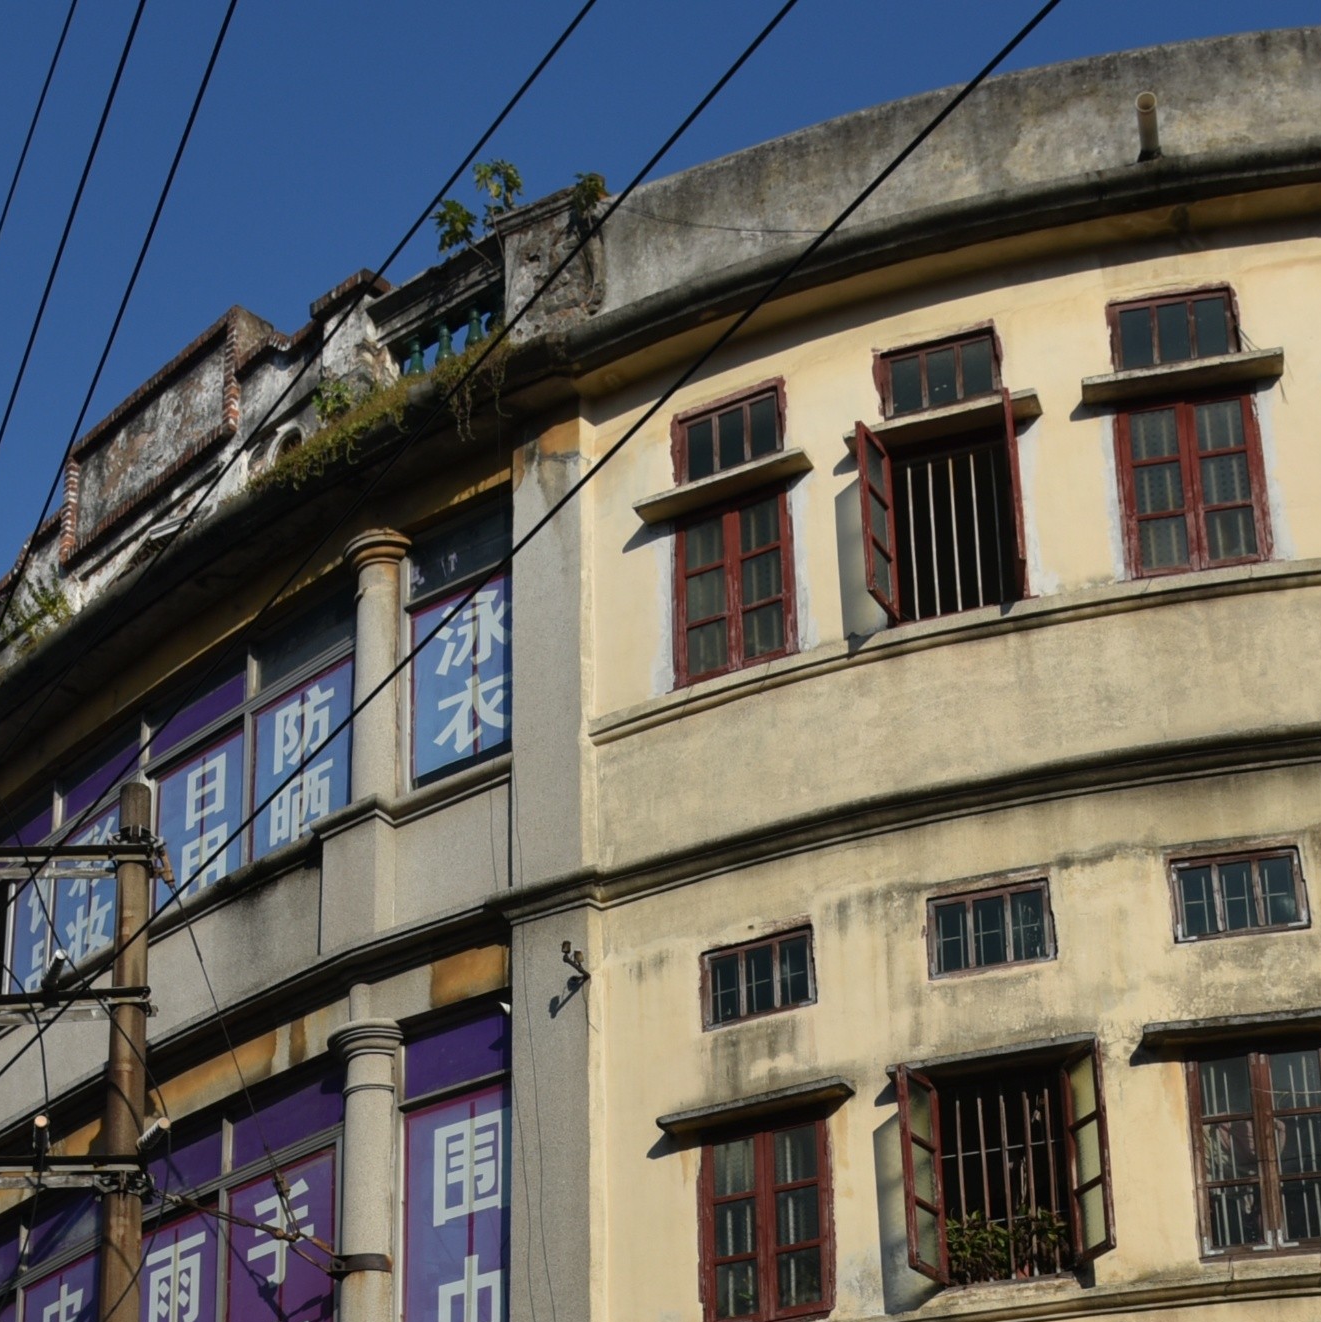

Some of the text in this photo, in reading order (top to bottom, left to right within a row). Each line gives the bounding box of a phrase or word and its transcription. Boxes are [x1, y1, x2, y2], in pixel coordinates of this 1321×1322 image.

[434, 588, 512, 753] 泳衣
[179, 752, 229, 899] 日用
[269, 686, 334, 847] 防晒
